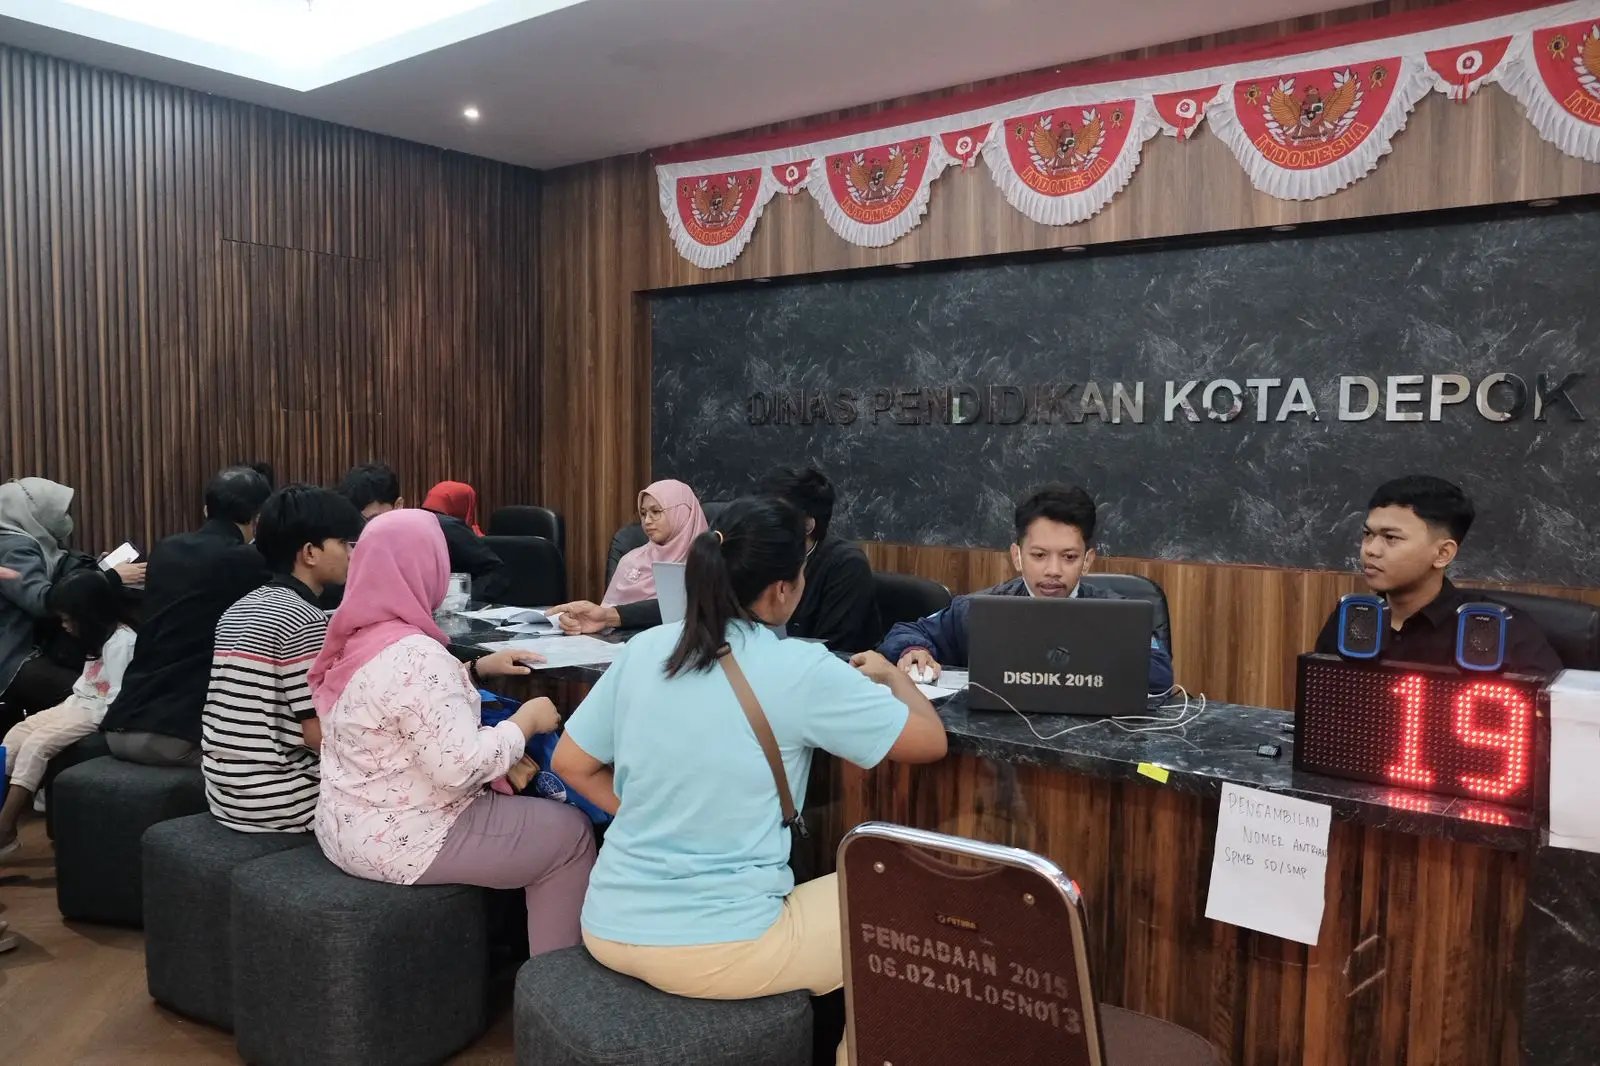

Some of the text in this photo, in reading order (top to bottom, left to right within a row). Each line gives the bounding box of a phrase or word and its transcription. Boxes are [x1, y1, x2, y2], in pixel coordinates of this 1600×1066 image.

[1257, 122, 1369, 167] INDONESIA
[1020, 157, 1109, 193] INDONESIA
[841, 187, 914, 221] INDONESIA
[686, 215, 745, 244] INDONESIA
[748, 371, 1586, 425] DINAS PENDIDIKAN KOTA DEPOK
[1003, 671, 1104, 688] DISDIK 2018
[1387, 674, 1527, 796] 19
[1243, 826, 1284, 847] NOMER
[1224, 847, 1307, 879] SPMB SD/SMP
[860, 923, 997, 976] PENGADAAN
